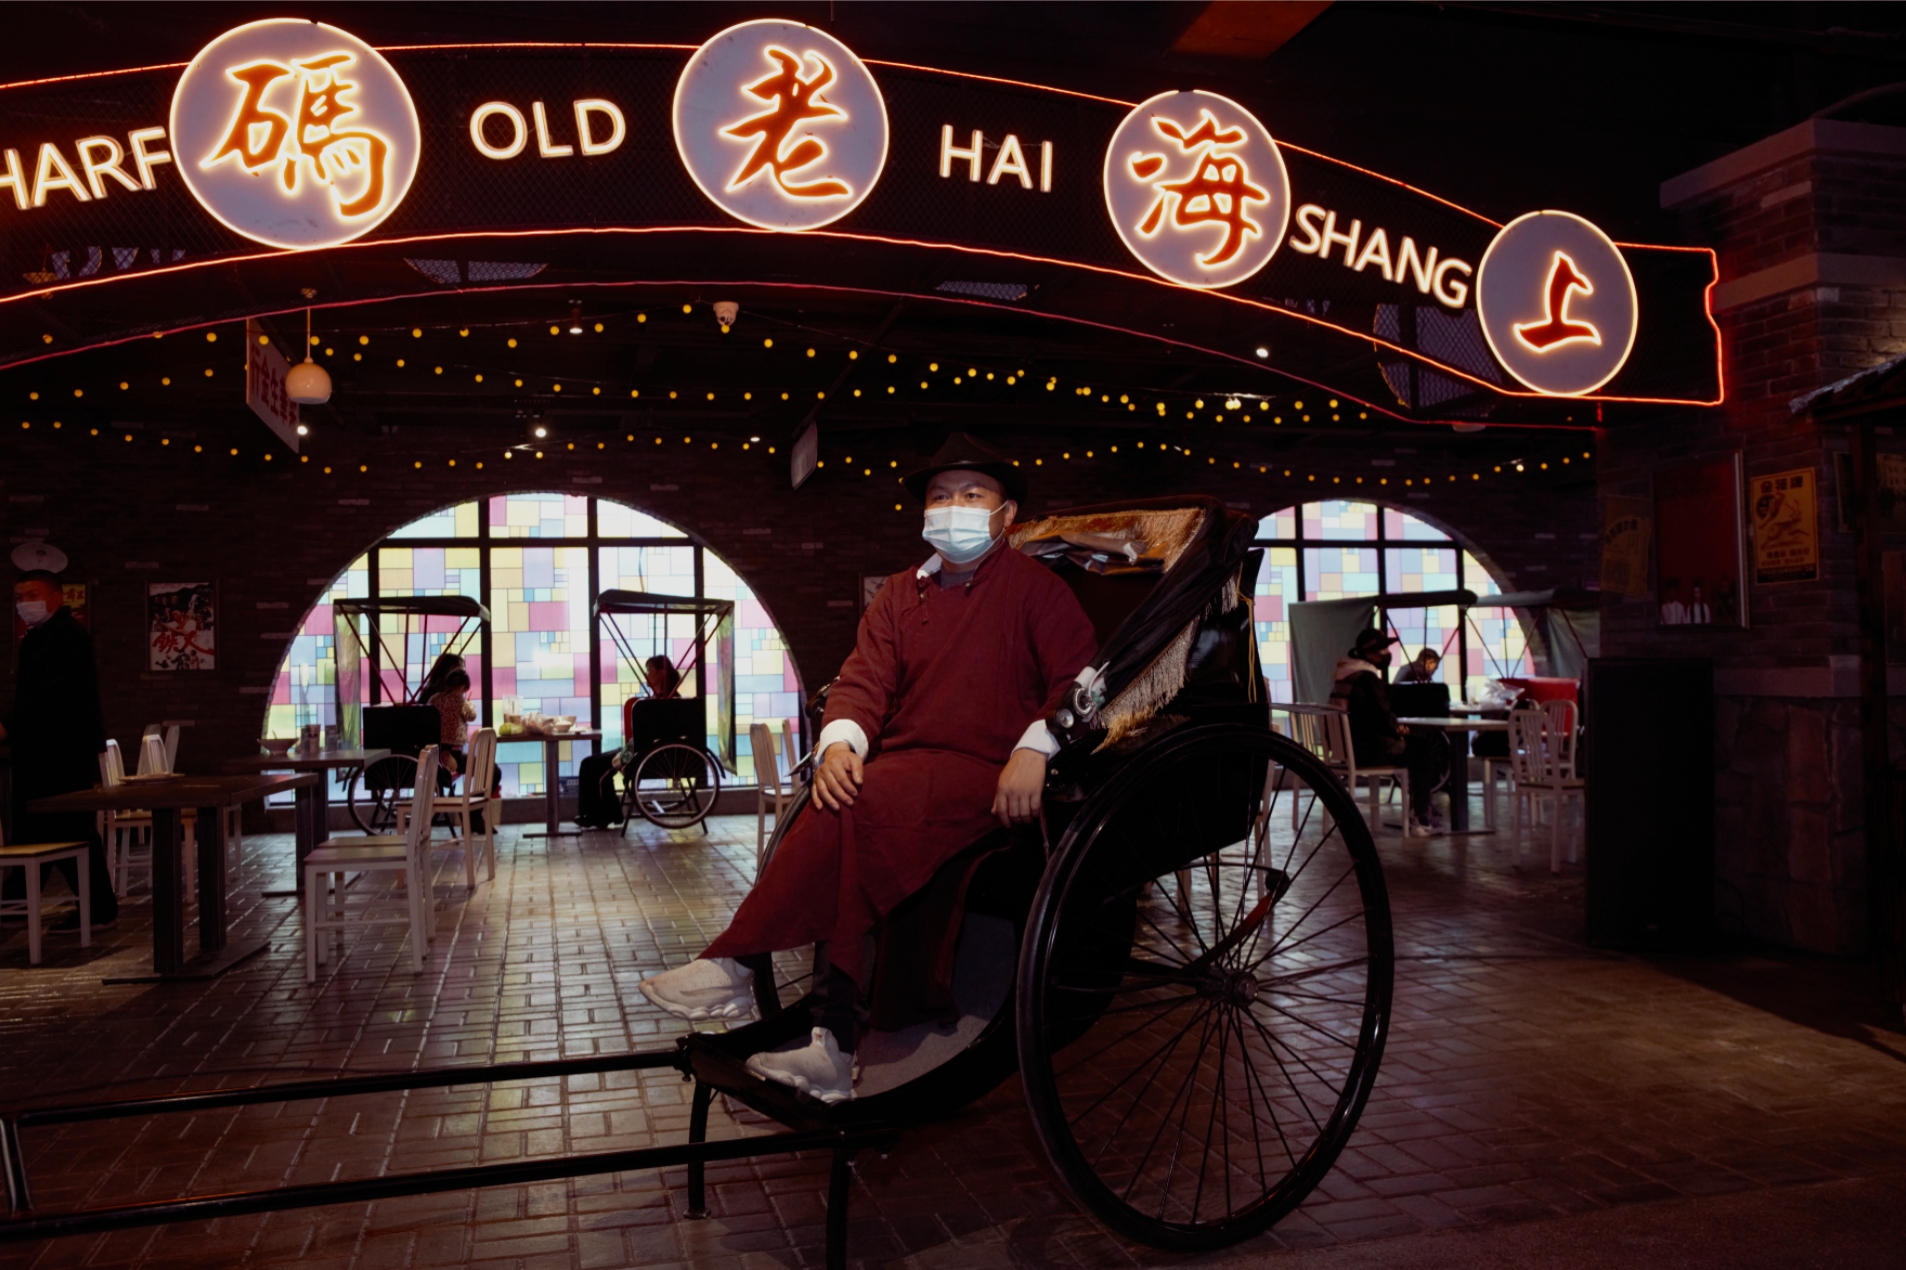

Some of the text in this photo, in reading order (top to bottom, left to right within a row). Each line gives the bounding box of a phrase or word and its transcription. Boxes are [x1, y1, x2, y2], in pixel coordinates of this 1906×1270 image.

[198, 45, 1602, 354] 碼 老 海 上
[469, 98, 627, 160] OLD
[938, 123, 1054, 194] HAI
[1289, 203, 1474, 310] SHANG
